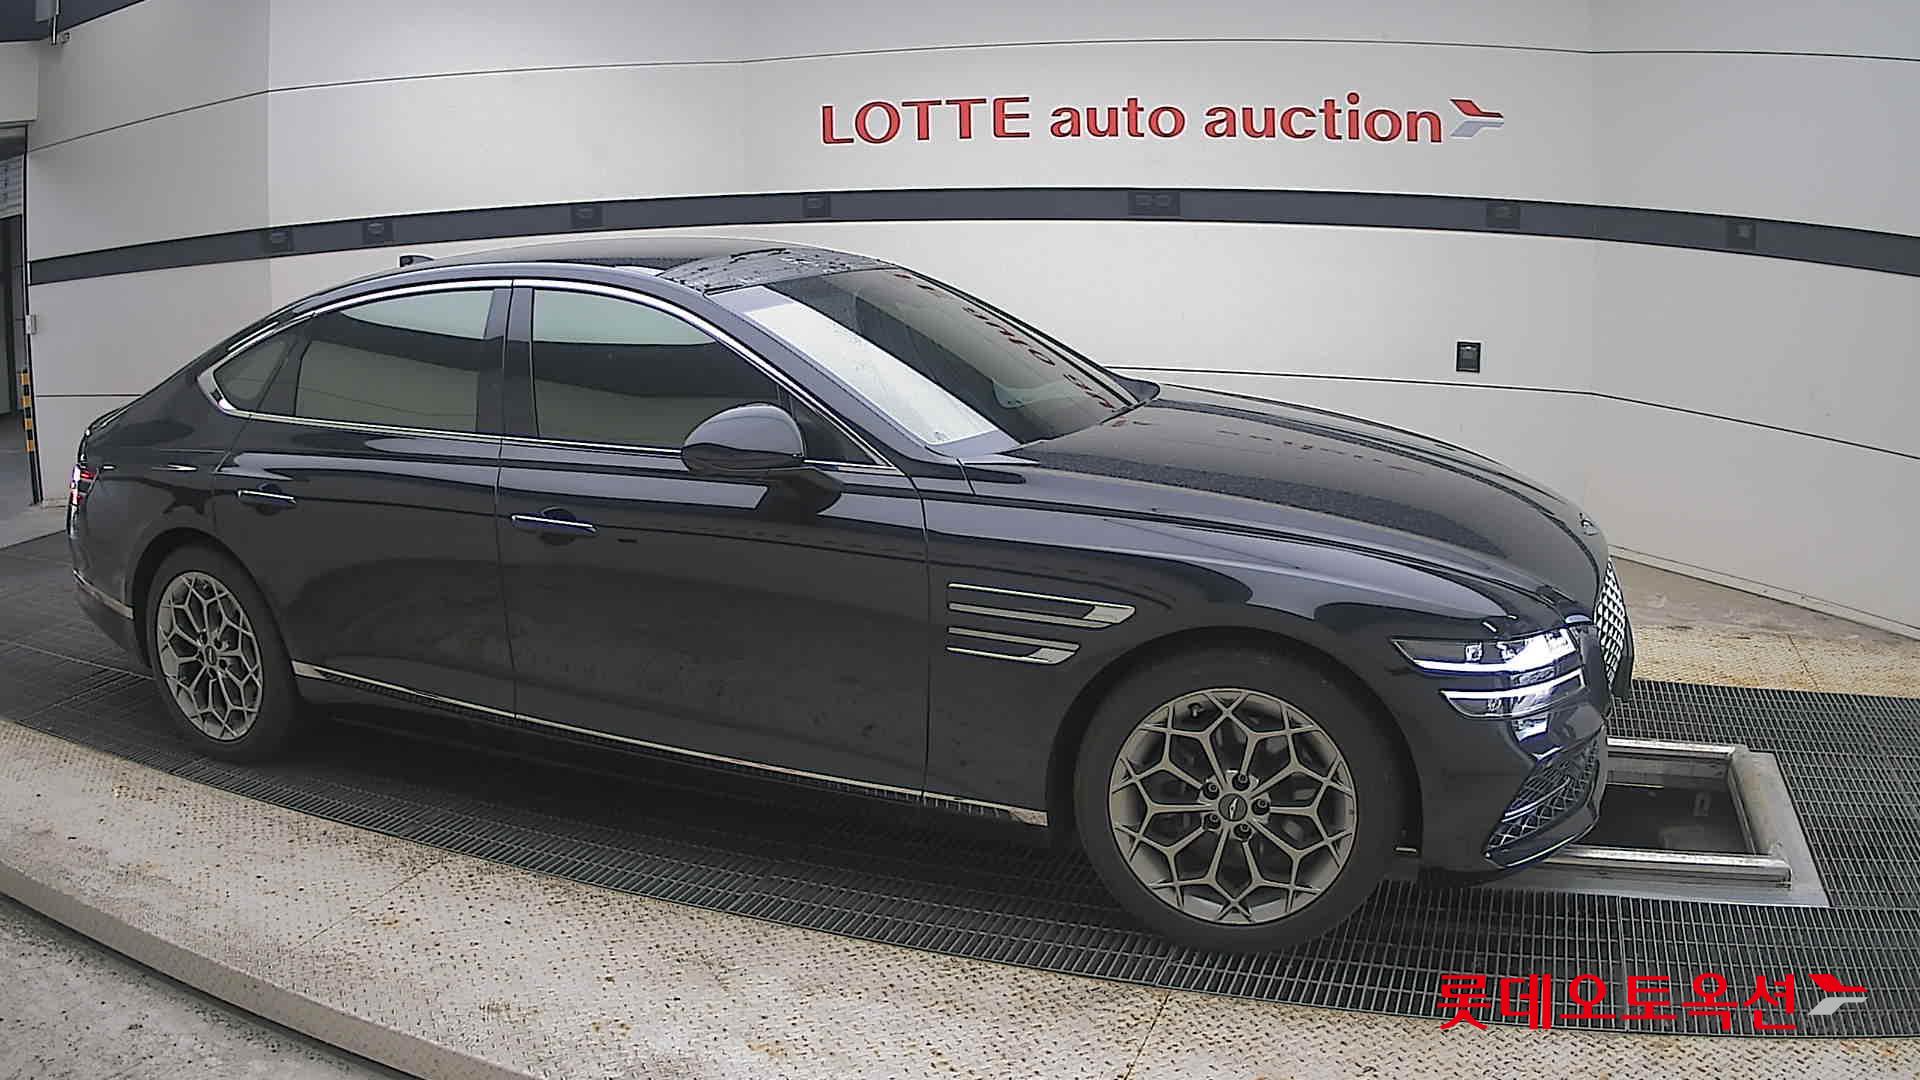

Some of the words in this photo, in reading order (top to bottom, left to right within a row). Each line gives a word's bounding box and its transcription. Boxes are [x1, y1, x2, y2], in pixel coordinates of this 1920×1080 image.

[822, 97, 1030, 144] LOTTE
[1050, 97, 1185, 138] auto
[1204, 92, 1442, 142] auction
